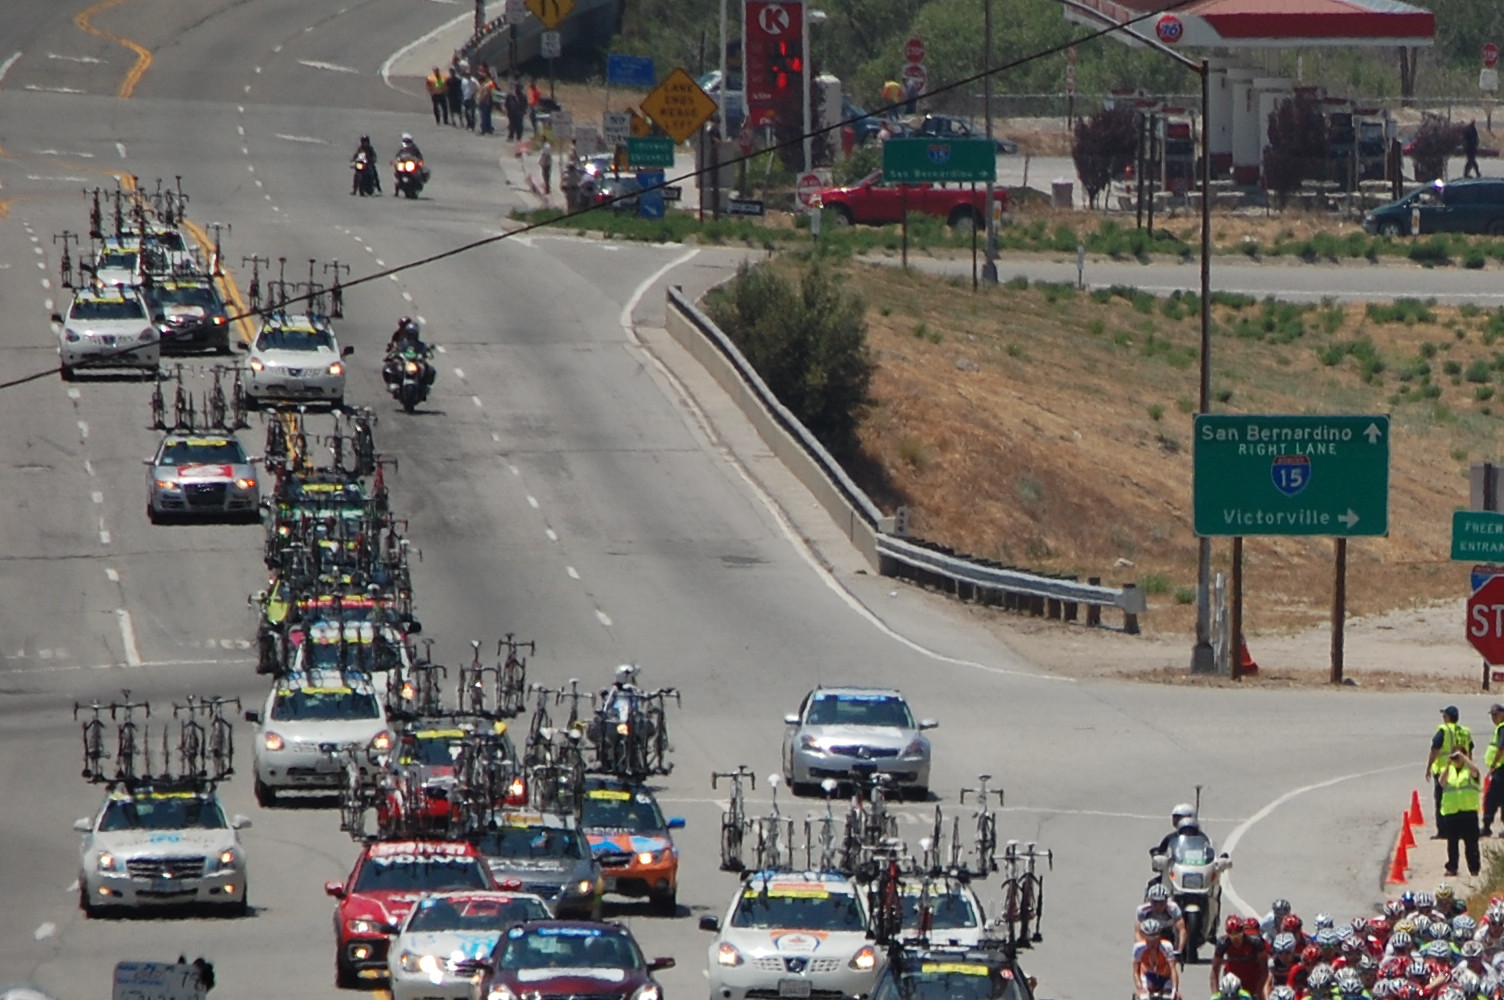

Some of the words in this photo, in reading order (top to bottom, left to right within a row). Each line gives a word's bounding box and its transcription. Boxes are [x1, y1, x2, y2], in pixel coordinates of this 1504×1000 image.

[1160, 23, 1181, 38] 76
[1202, 425, 1239, 441] San
[1247, 425, 1352, 441] Bernardino
[1238, 443, 1286, 455] RIGHT
[1296, 443, 1337, 455] LANE
[1280, 468, 1303, 487] 15
[1223, 508, 1330, 525] Victorville
[372, 854, 475, 867] VOLVO
